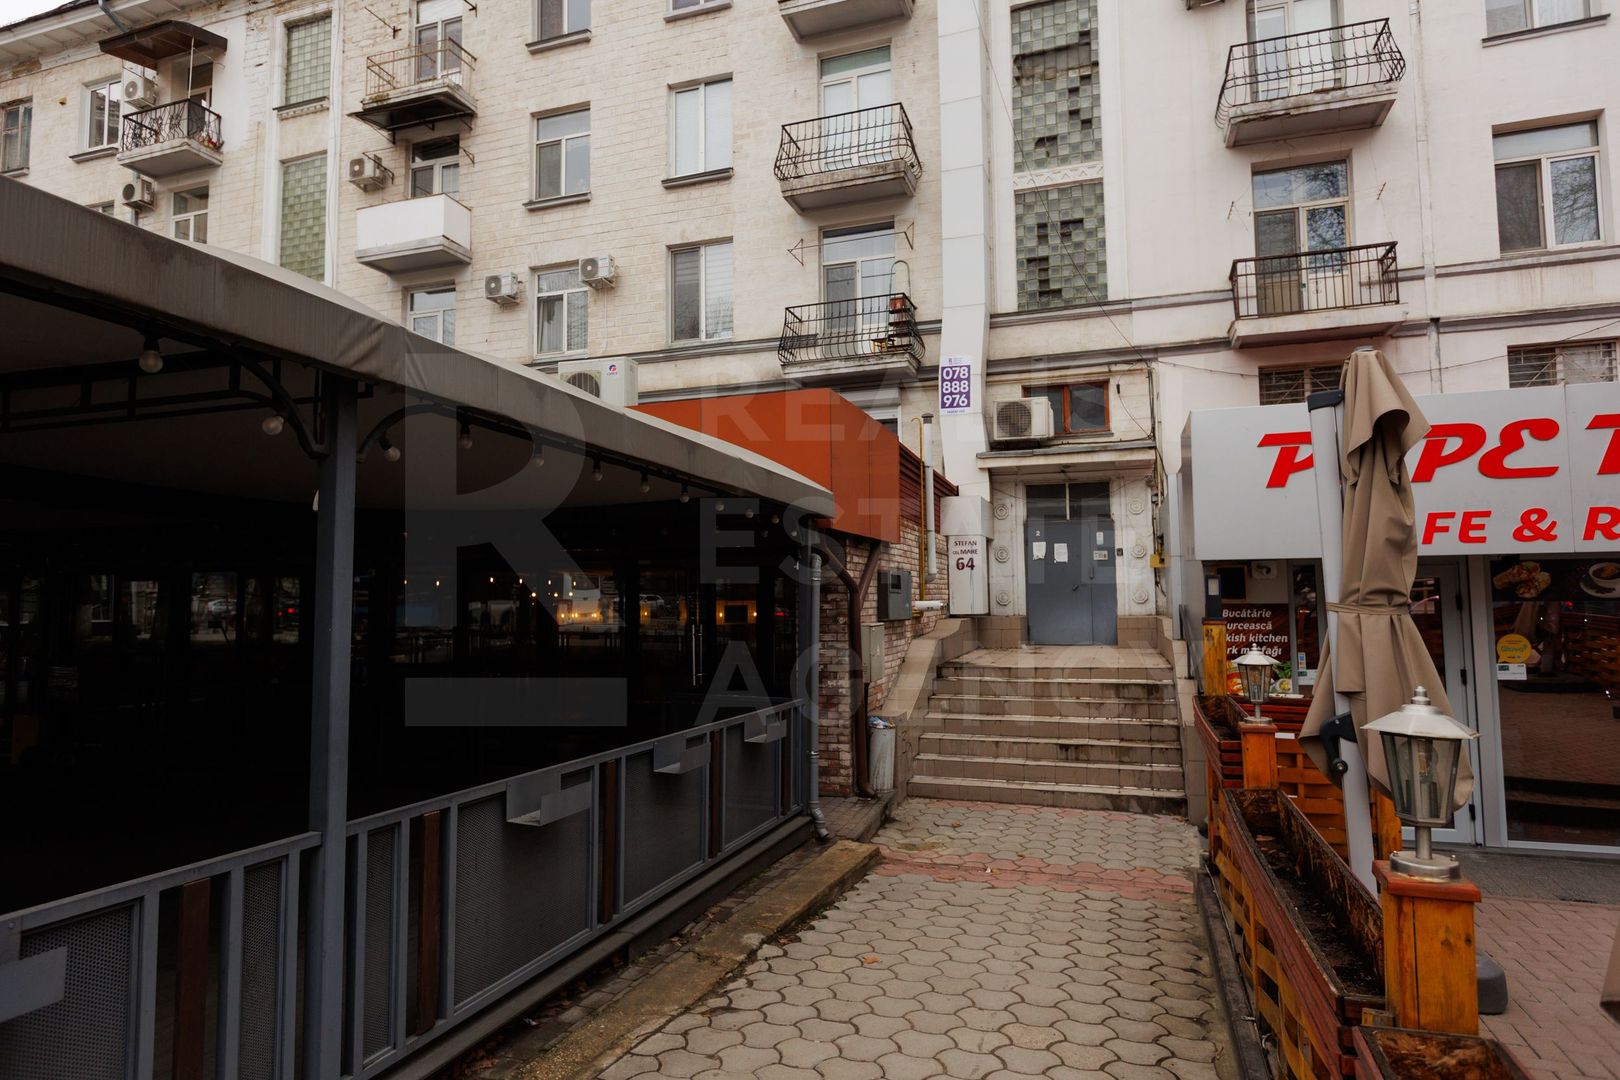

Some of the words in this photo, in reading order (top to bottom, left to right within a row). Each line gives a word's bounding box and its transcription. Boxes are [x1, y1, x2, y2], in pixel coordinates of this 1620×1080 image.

[943, 366, 968, 379] 078
[943, 380, 968, 393] 888
[943, 394, 968, 407] 976
[1512, 507, 1558, 543] &
[956, 557, 975, 571] 64
[1224, 621, 1273, 630] urcească
[1248, 633, 1288, 642] kitchen
